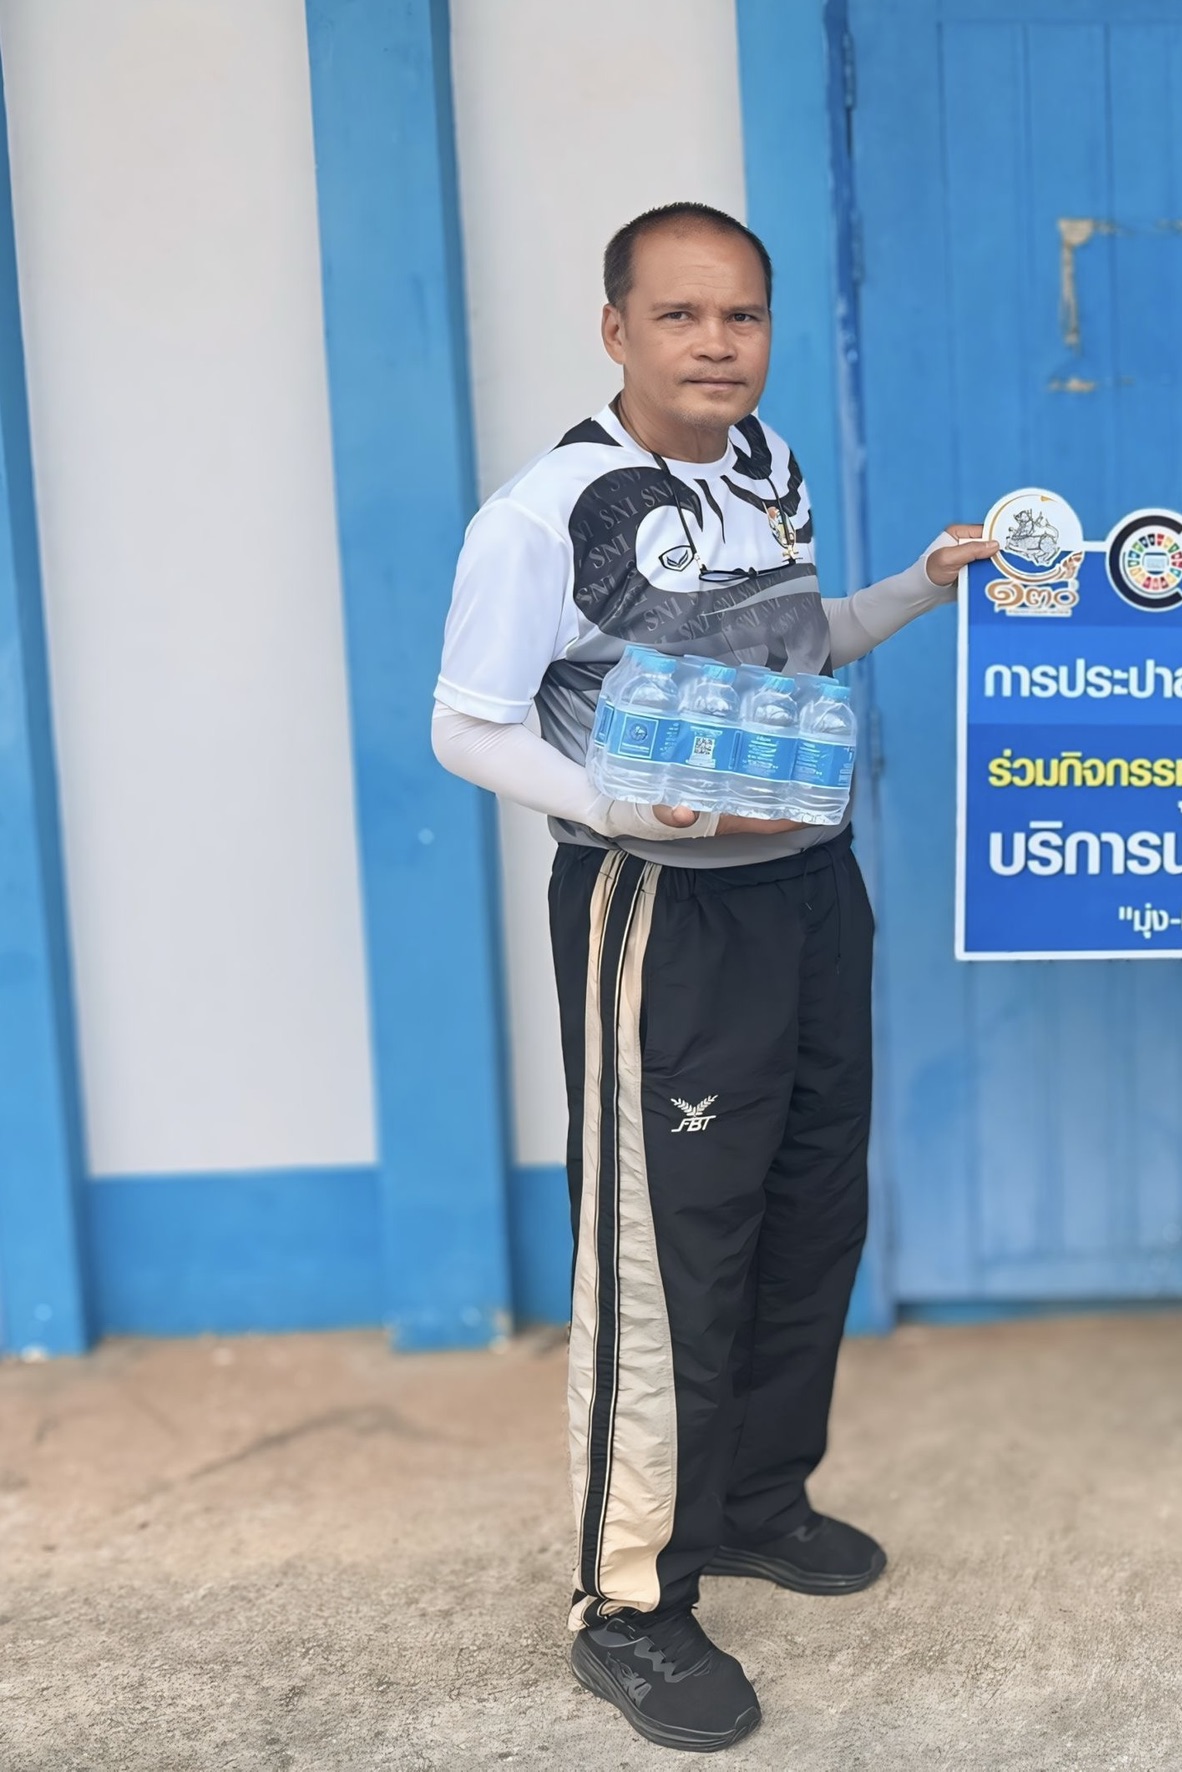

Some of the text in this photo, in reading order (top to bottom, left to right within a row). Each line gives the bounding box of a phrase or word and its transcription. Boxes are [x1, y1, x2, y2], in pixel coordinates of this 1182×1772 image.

[599, 497, 638, 530] SNI
[588, 534, 631, 569] SNI
[643, 597, 683, 632] SNI
[671, 1115, 717, 1133] FBT
